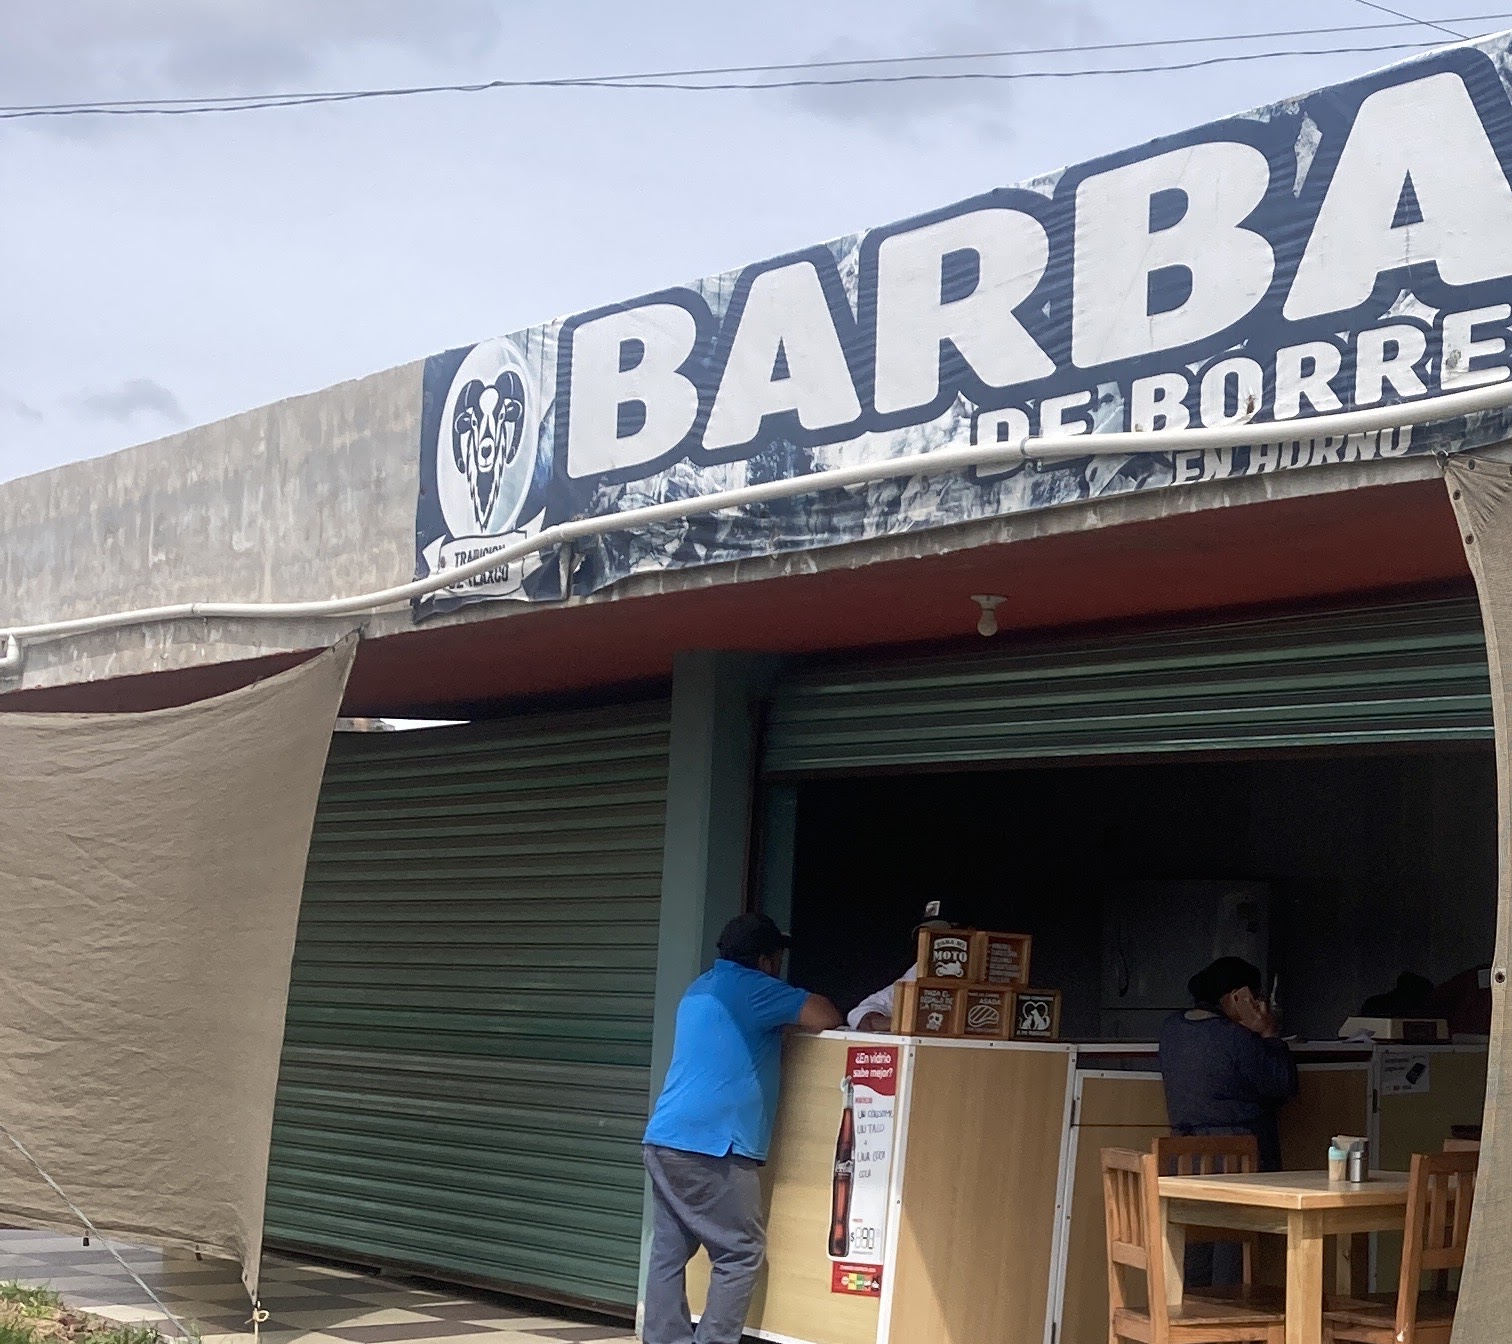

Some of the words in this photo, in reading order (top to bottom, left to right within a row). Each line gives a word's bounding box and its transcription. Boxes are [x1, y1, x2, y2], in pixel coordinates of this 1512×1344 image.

[1172, 447, 1233, 485] EN
[454, 544, 506, 568] TRADICI
[932, 950, 968, 963] MOTO
[870, 1051, 892, 1064] vidrio
[853, 1066, 869, 1078] sabe
